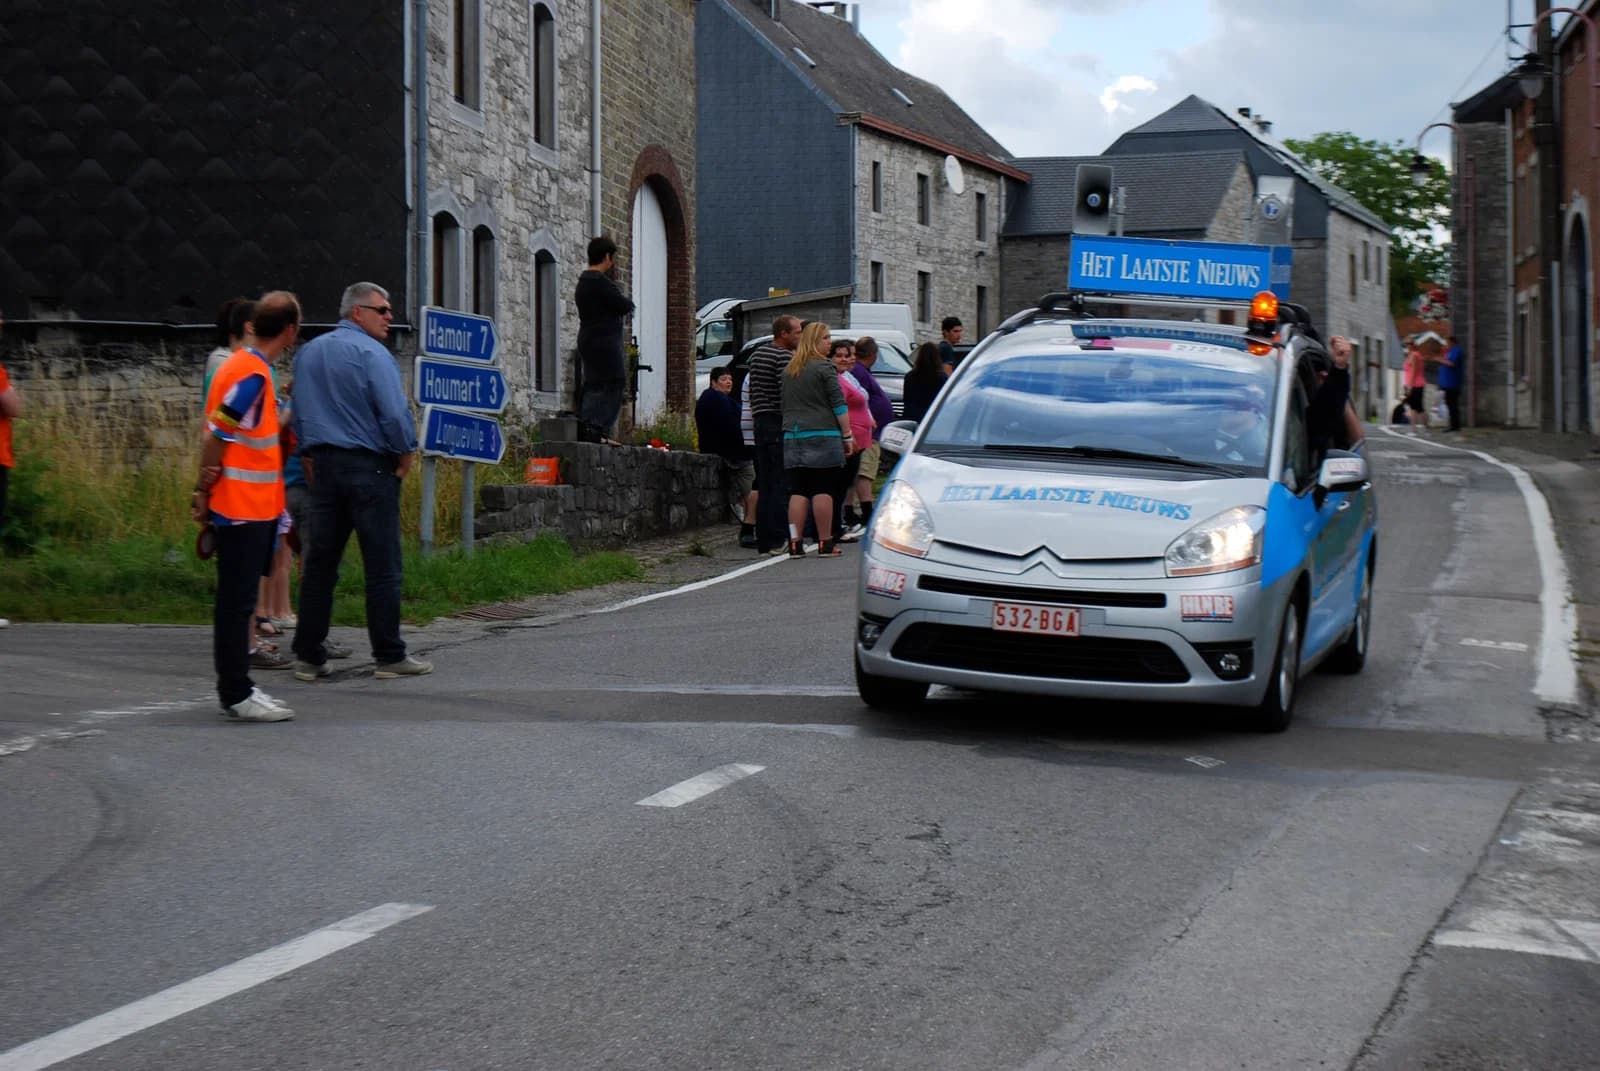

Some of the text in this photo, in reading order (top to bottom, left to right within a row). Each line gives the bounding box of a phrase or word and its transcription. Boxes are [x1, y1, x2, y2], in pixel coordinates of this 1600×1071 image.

[1080, 251, 1260, 288] HET LAATSTE NIEUWS
[427, 316, 489, 354] Hamoir 7
[425, 368, 498, 405] Houmart 3
[989, 485, 1094, 505] LAATSTE
[1097, 490, 1193, 520] NIEUWS
